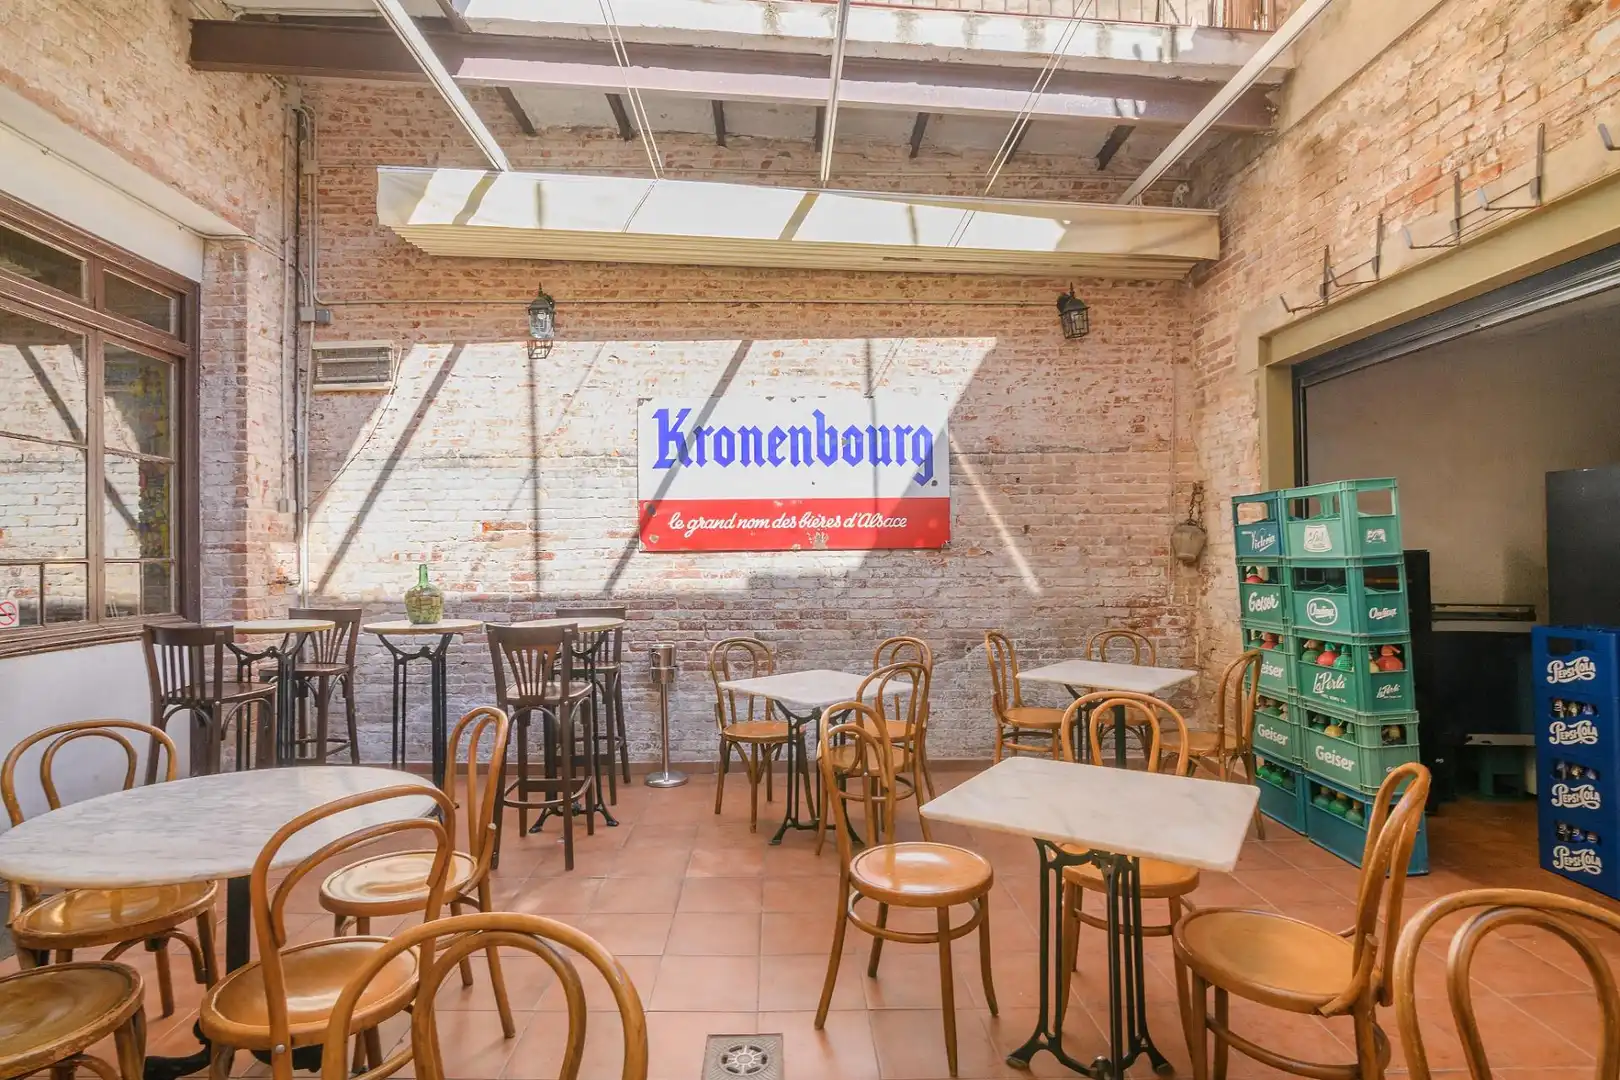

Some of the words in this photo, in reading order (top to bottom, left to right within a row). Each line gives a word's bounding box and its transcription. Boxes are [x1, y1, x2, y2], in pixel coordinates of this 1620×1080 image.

[651, 407, 934, 487] Kronenbourg
[668, 512, 685, 530] le
[684, 512, 738, 538] grand
[737, 517, 771, 530] nom
[771, 512, 797, 530] des
[798, 511, 842, 530] bières
[1260, 661, 1284, 678] eiser
[1257, 723, 1289, 746] Geiser
[1315, 745, 1355, 772] Geiser
